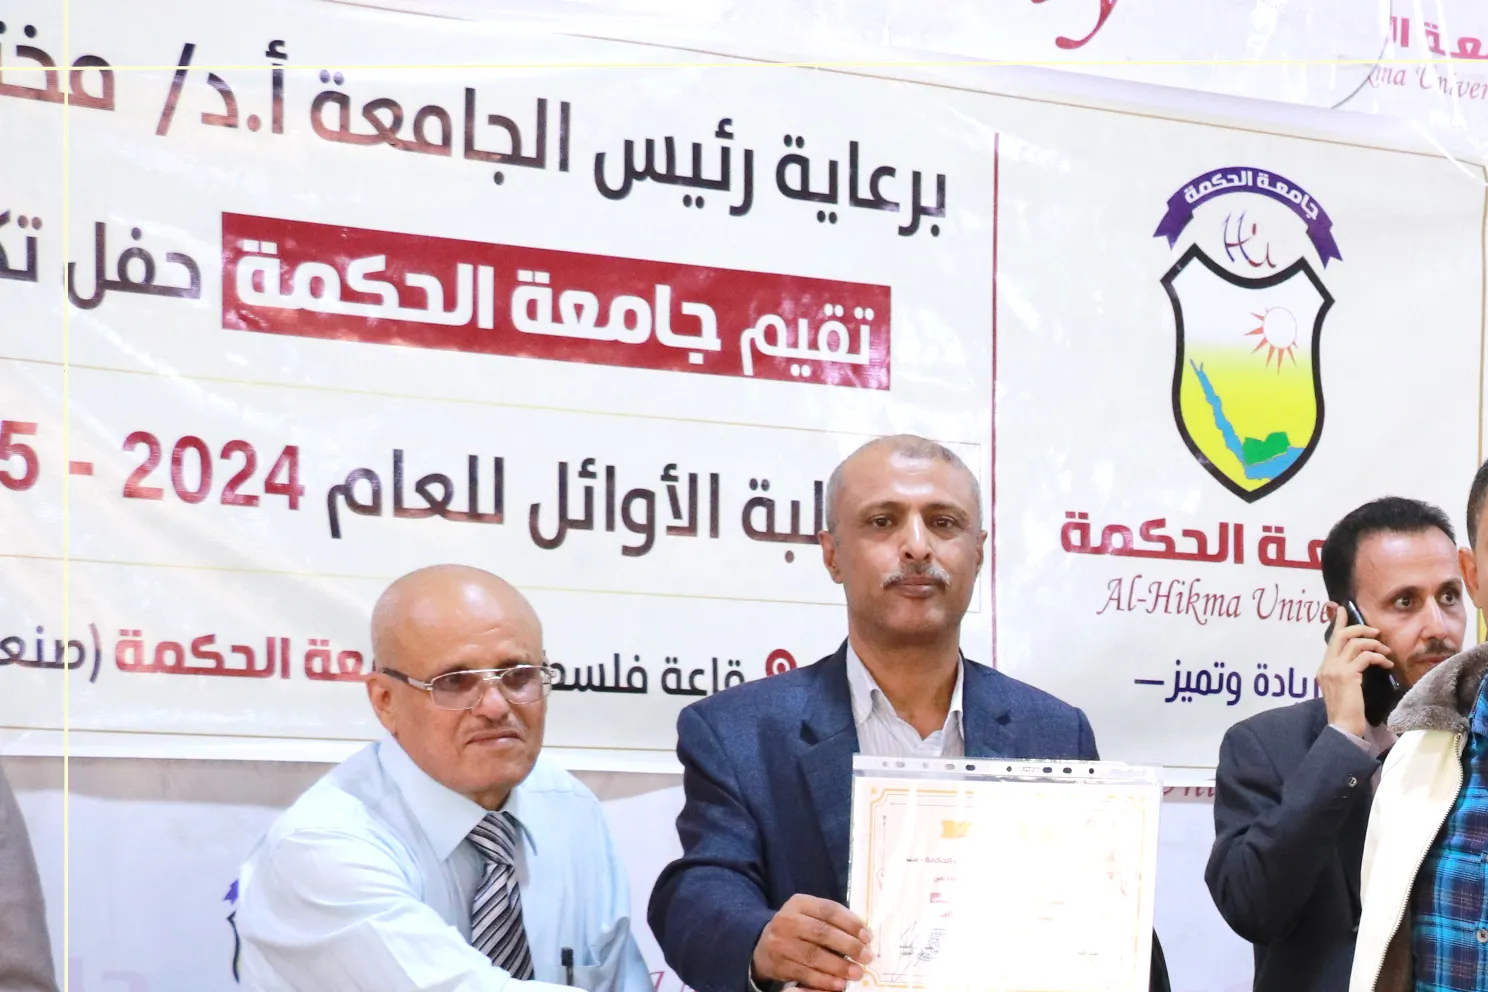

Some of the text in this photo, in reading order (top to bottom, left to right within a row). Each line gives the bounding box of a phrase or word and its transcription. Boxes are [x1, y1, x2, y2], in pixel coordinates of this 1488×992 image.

[310, 69, 571, 186] الجامعة
[594, 118, 755, 216] رئيس
[775, 133, 947, 237] برعاية
[1183, 170, 1319, 220] جامعة الحكمة
[64, 221, 202, 310] حفل
[235, 239, 495, 330] الحكمة
[511, 269, 723, 365] جامعة
[739, 303, 876, 377] تقيم
[122, 430, 306, 511] 2024
[327, 448, 505, 539] للعام
[528, 457, 720, 557] الأوائل
[741, 478, 824, 564] لبة
[1060, 510, 1245, 565] الحكمة
[1095, 574, 1334, 626] Al-Hikma Unive
[115, 628, 291, 680] الحكمة
[661, 656, 746, 697] قاعة
[1164, 658, 1242, 706] وتميز
